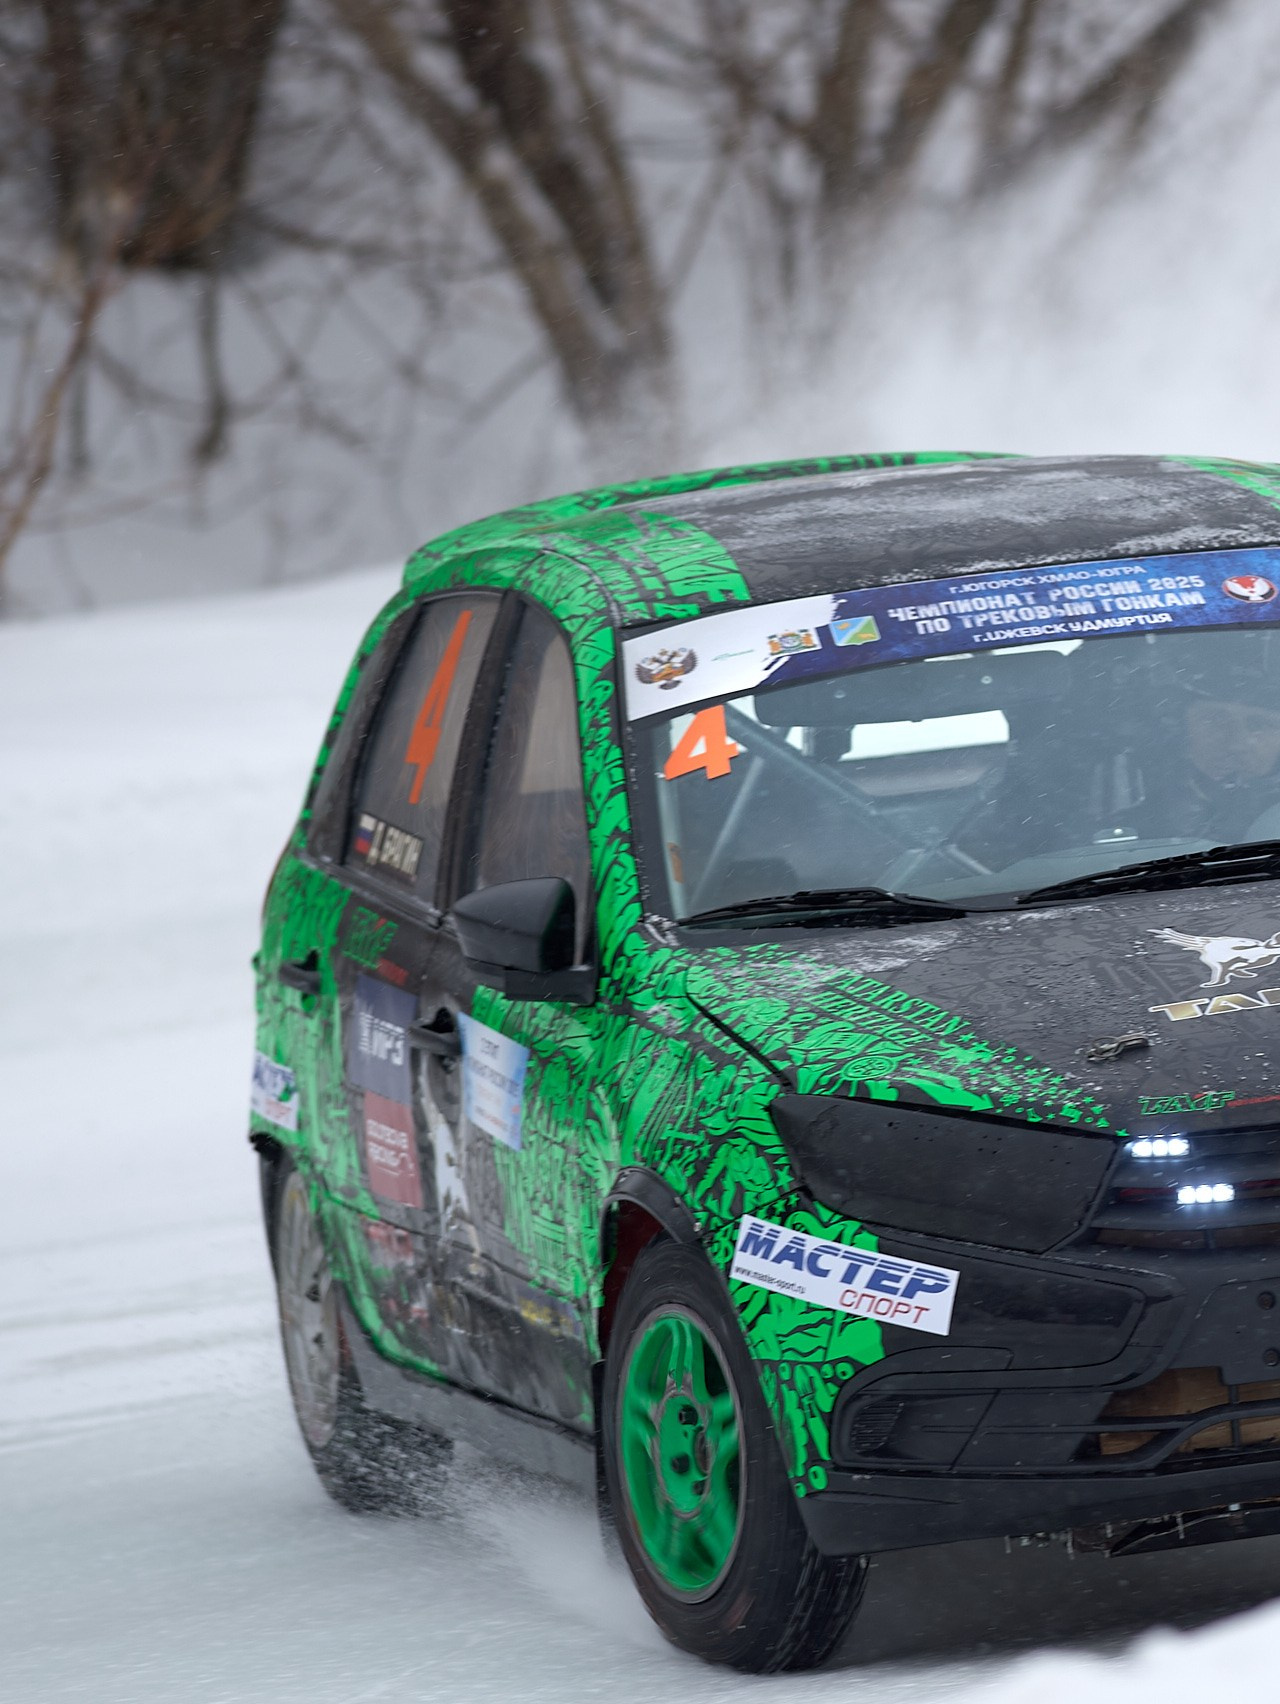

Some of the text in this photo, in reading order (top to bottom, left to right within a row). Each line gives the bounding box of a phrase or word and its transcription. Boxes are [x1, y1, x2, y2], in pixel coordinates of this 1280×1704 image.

[888, 575, 1206, 621] ЧЕМПИОНАТ РОССИИ 2025
[948, 565, 1147, 594] г.ЮГОРСК ХМАО-ЮГРА
[916, 591, 1206, 635] ПО ТРЕКОВЫМ ГОНКАМ
[1068, 613, 1173, 632] УДМУРТИЯ
[405, 610, 473, 804] 4
[664, 705, 739, 780] 4
[809, 990, 934, 1047] HERITAGE
[822, 967, 971, 1036] TATARSTAN
[739, 1222, 951, 1299] МАСТЕР
[838, 1289, 930, 1324] СПОРТ
